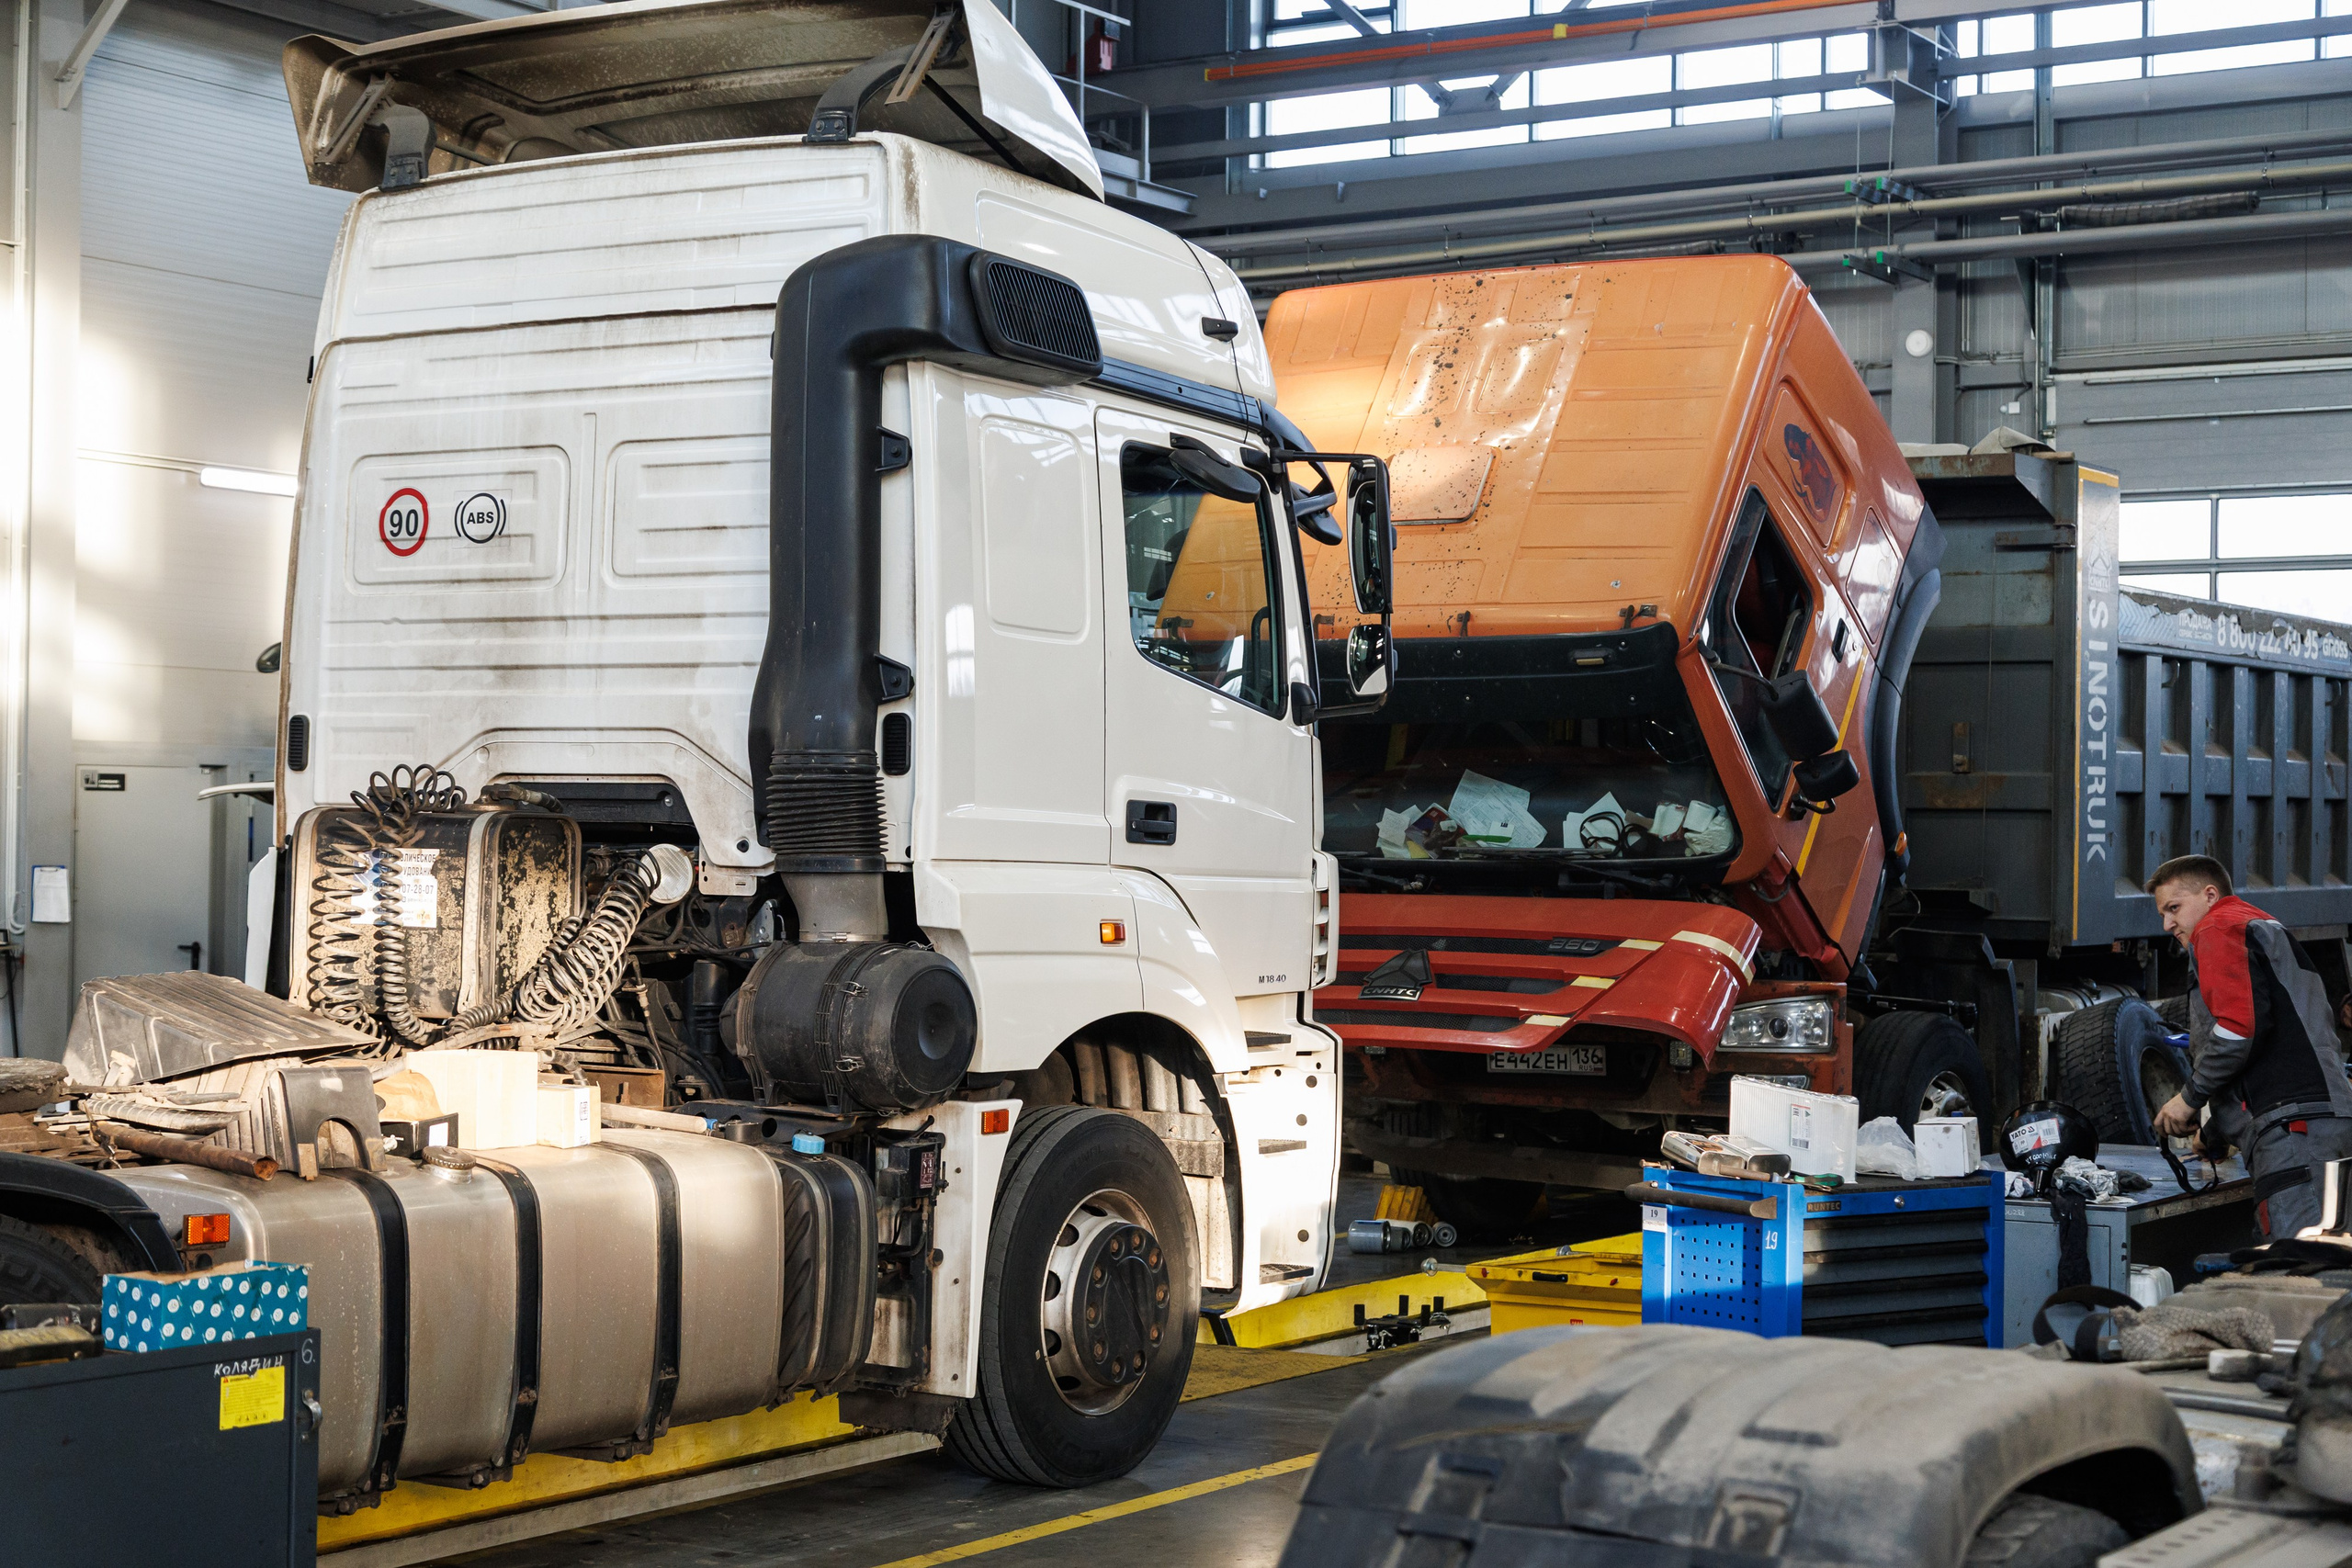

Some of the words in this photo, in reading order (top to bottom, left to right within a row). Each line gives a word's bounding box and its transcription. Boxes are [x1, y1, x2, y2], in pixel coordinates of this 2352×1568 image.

[390, 509, 418, 537] 90
[467, 512, 494, 525] ABS
[2217, 613, 2227, 647] 8
[2303, 628, 2319, 660] 95
[2323, 637, 2348, 660] GROSS
[1363, 987, 1417, 997] CNHTC
[1572, 1048, 1600, 1065] 136
[2011, 1128, 2027, 1140] YATO
[1807, 1198, 1840, 1211] RUNTEC
[1651, 1210, 1657, 1218] 19
[1765, 1230, 1778, 1249] 19
